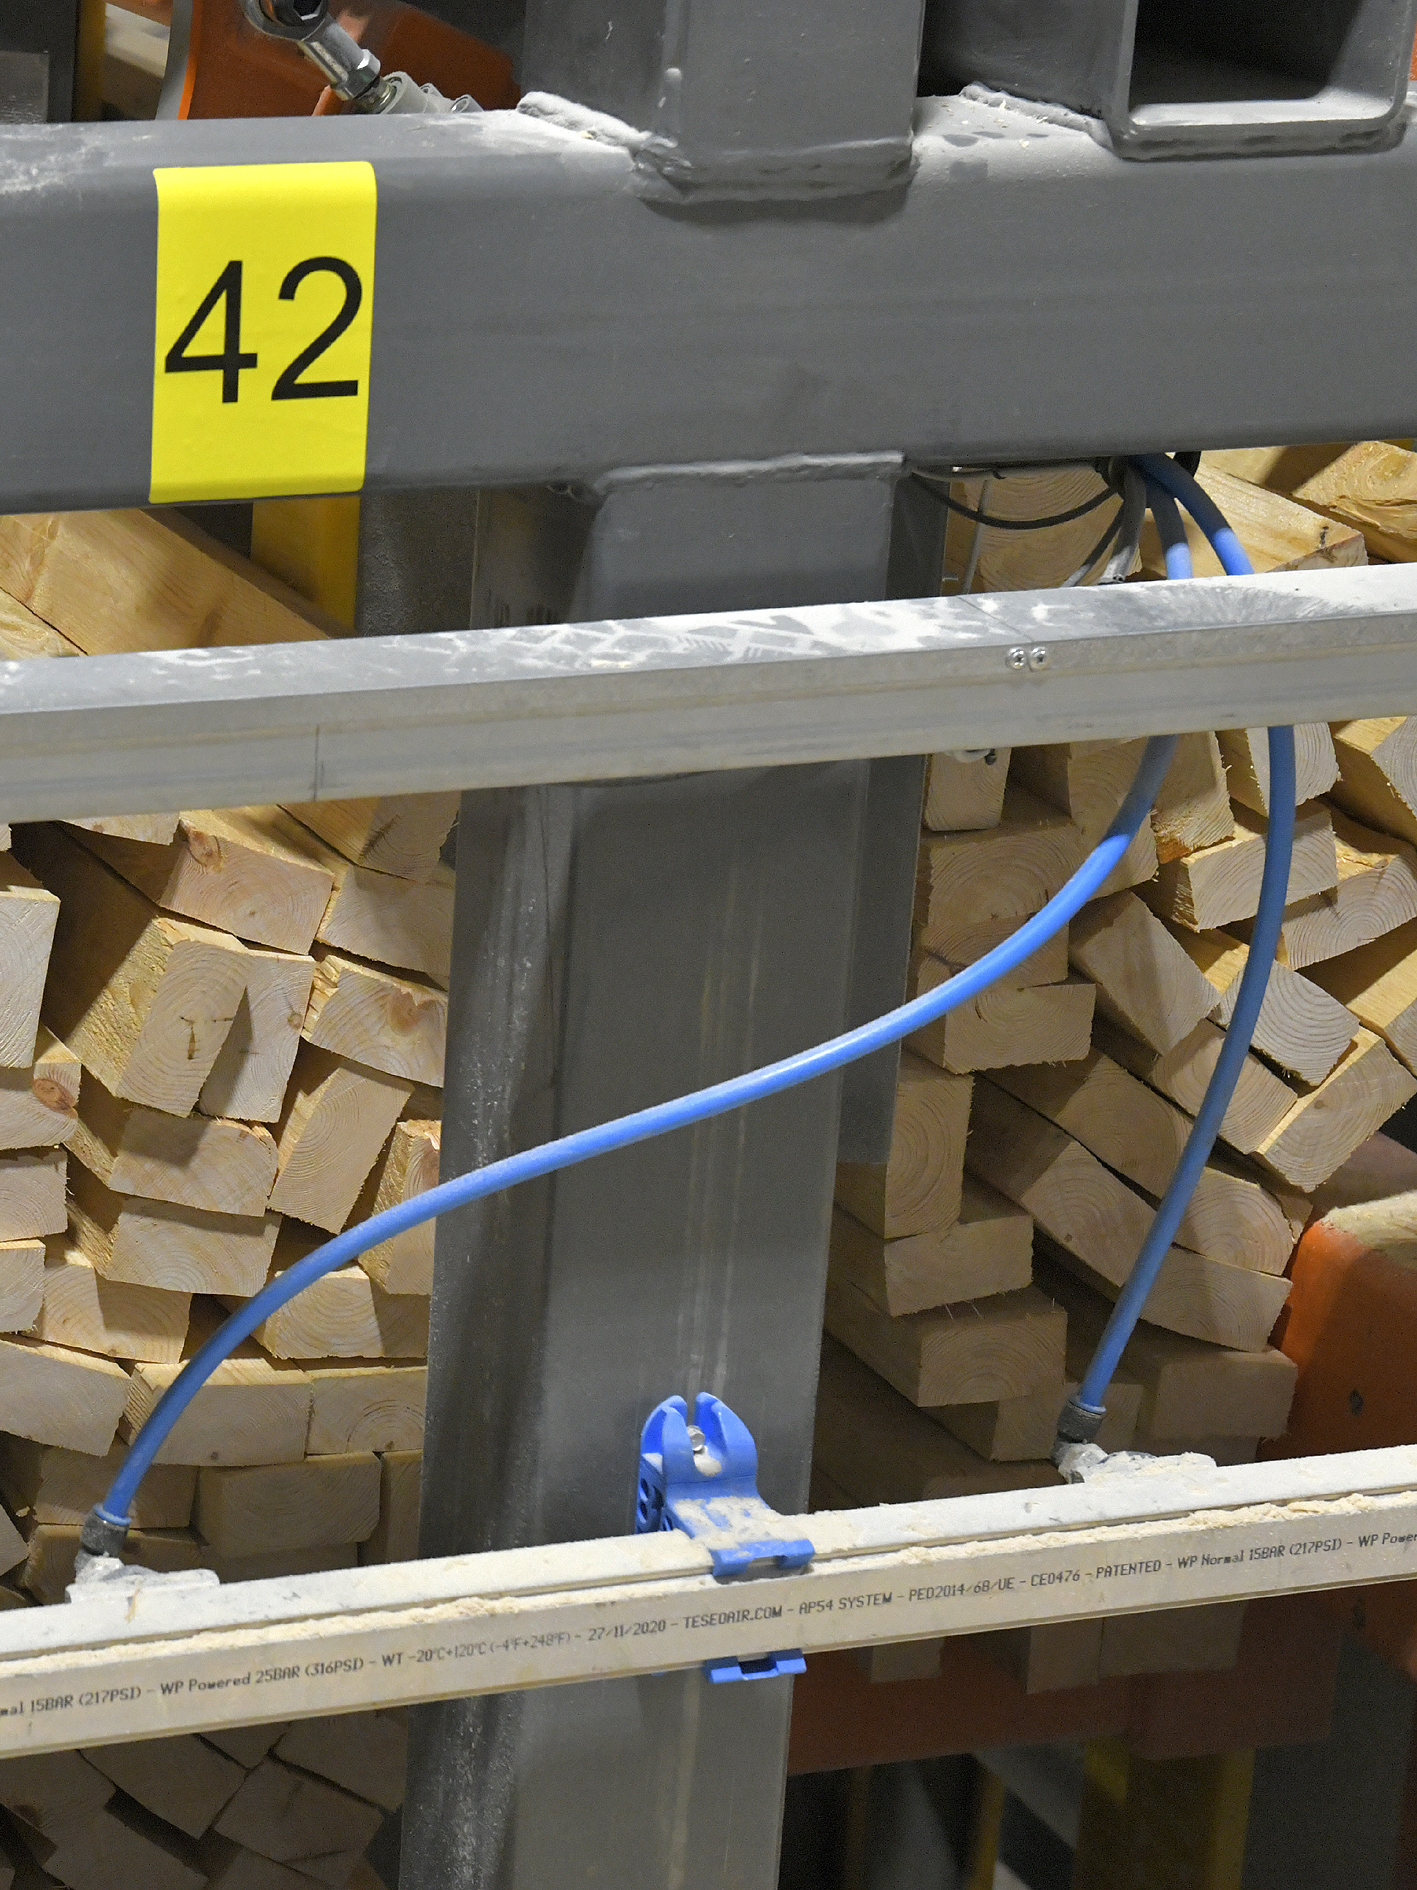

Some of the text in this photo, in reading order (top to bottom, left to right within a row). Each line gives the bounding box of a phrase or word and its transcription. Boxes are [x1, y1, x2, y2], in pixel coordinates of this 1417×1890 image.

[165, 256, 363, 404] 42
[30, 1694, 74, 1714] 15BAR
[78, 1685, 142, 1706] (217PSI)
[159, 1680, 185, 1696] WP
[188, 1671, 252, 1693] Powered
[255, 1665, 301, 1684] 25BAR
[304, 1657, 365, 1677] (316PSI)
[381, 1651, 404, 1668] WT
[798, 1599, 834, 1616] AP54
[838, 1591, 893, 1611] SYSTEM
[1030, 1569, 1081, 1587] CE0476
[1095, 1559, 1162, 1580] PATENTED
[1177, 1554, 1199, 1569] WP
[1200, 1549, 1245, 1567] Normal
[1248, 1544, 1286, 1562] 15BAR
[1288, 1537, 1343, 1556] (217PSI)
[1357, 1533, 1379, 1548] WP
